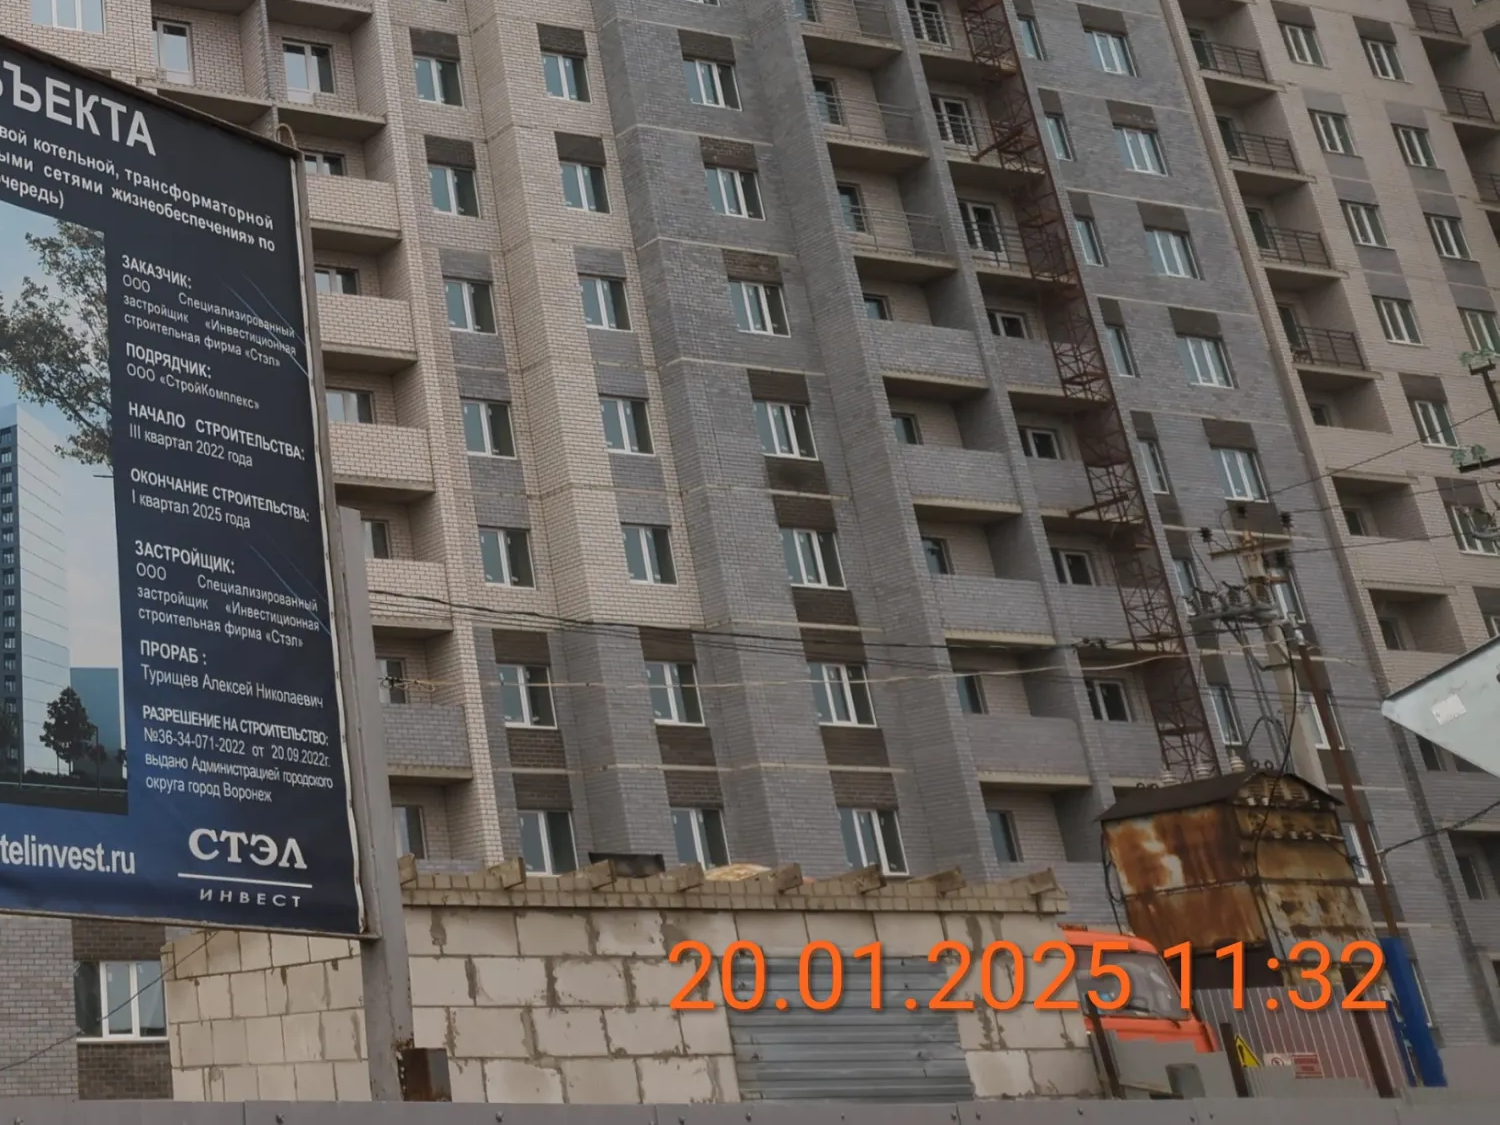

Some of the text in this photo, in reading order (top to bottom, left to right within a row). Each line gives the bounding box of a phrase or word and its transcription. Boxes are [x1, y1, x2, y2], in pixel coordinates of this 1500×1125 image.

[33, 137, 120, 179] котельной,
[125, 167, 274, 231] трансформаторной
[44, 164, 103, 195] сетями
[112, 186, 255, 253] жизнеобеспечения»
[258, 236, 276, 252] по
[122, 254, 192, 289] ЗАКАЗЧИК:
[123, 275, 295, 338] ООО Специализированный
[124, 296, 296, 356] застройщик «Инвестиционная
[124, 313, 280, 368] строительная фирма «Стэл»
[126, 343, 211, 379] ПОДРЯДЧИК:
[126, 363, 260, 410] ООО «СтройКомплекс»
[128, 402, 305, 460] НАЧАЛО СТРОИТЕЛЬСТВА:
[129, 424, 253, 468] III квартал 2022 года
[131, 468, 309, 523] ОКОНЧАНИЕ СТРОИТЕЛЬСТВА:
[139, 493, 189, 516] квартал
[193, 502, 222, 522] 2025
[225, 514, 250, 529] года
[135, 540, 235, 574] ЗАСТРОЙЩИК:
[136, 562, 317, 612] ООО Специализированный
[137, 586, 319, 632] застройщик «Инвестиционная
[138, 609, 303, 648] строительная фирма «Стэл»
[141, 663, 323, 708] Турищев Алексей Николаевич
[143, 705, 328, 746] РАЗРЕШЕНИЕ НА СТРОИТЕЛЬСТВО:
[144, 727, 330, 767] №36-34-071-2022 от 20.09.2022г.
[145, 754, 333, 789] выдано Администрацией городского
[146, 776, 272, 802] округа город Воронеж
[188, 828, 307, 869] СТЭЛ
[200, 888, 301, 907] ИНВЕСТ
